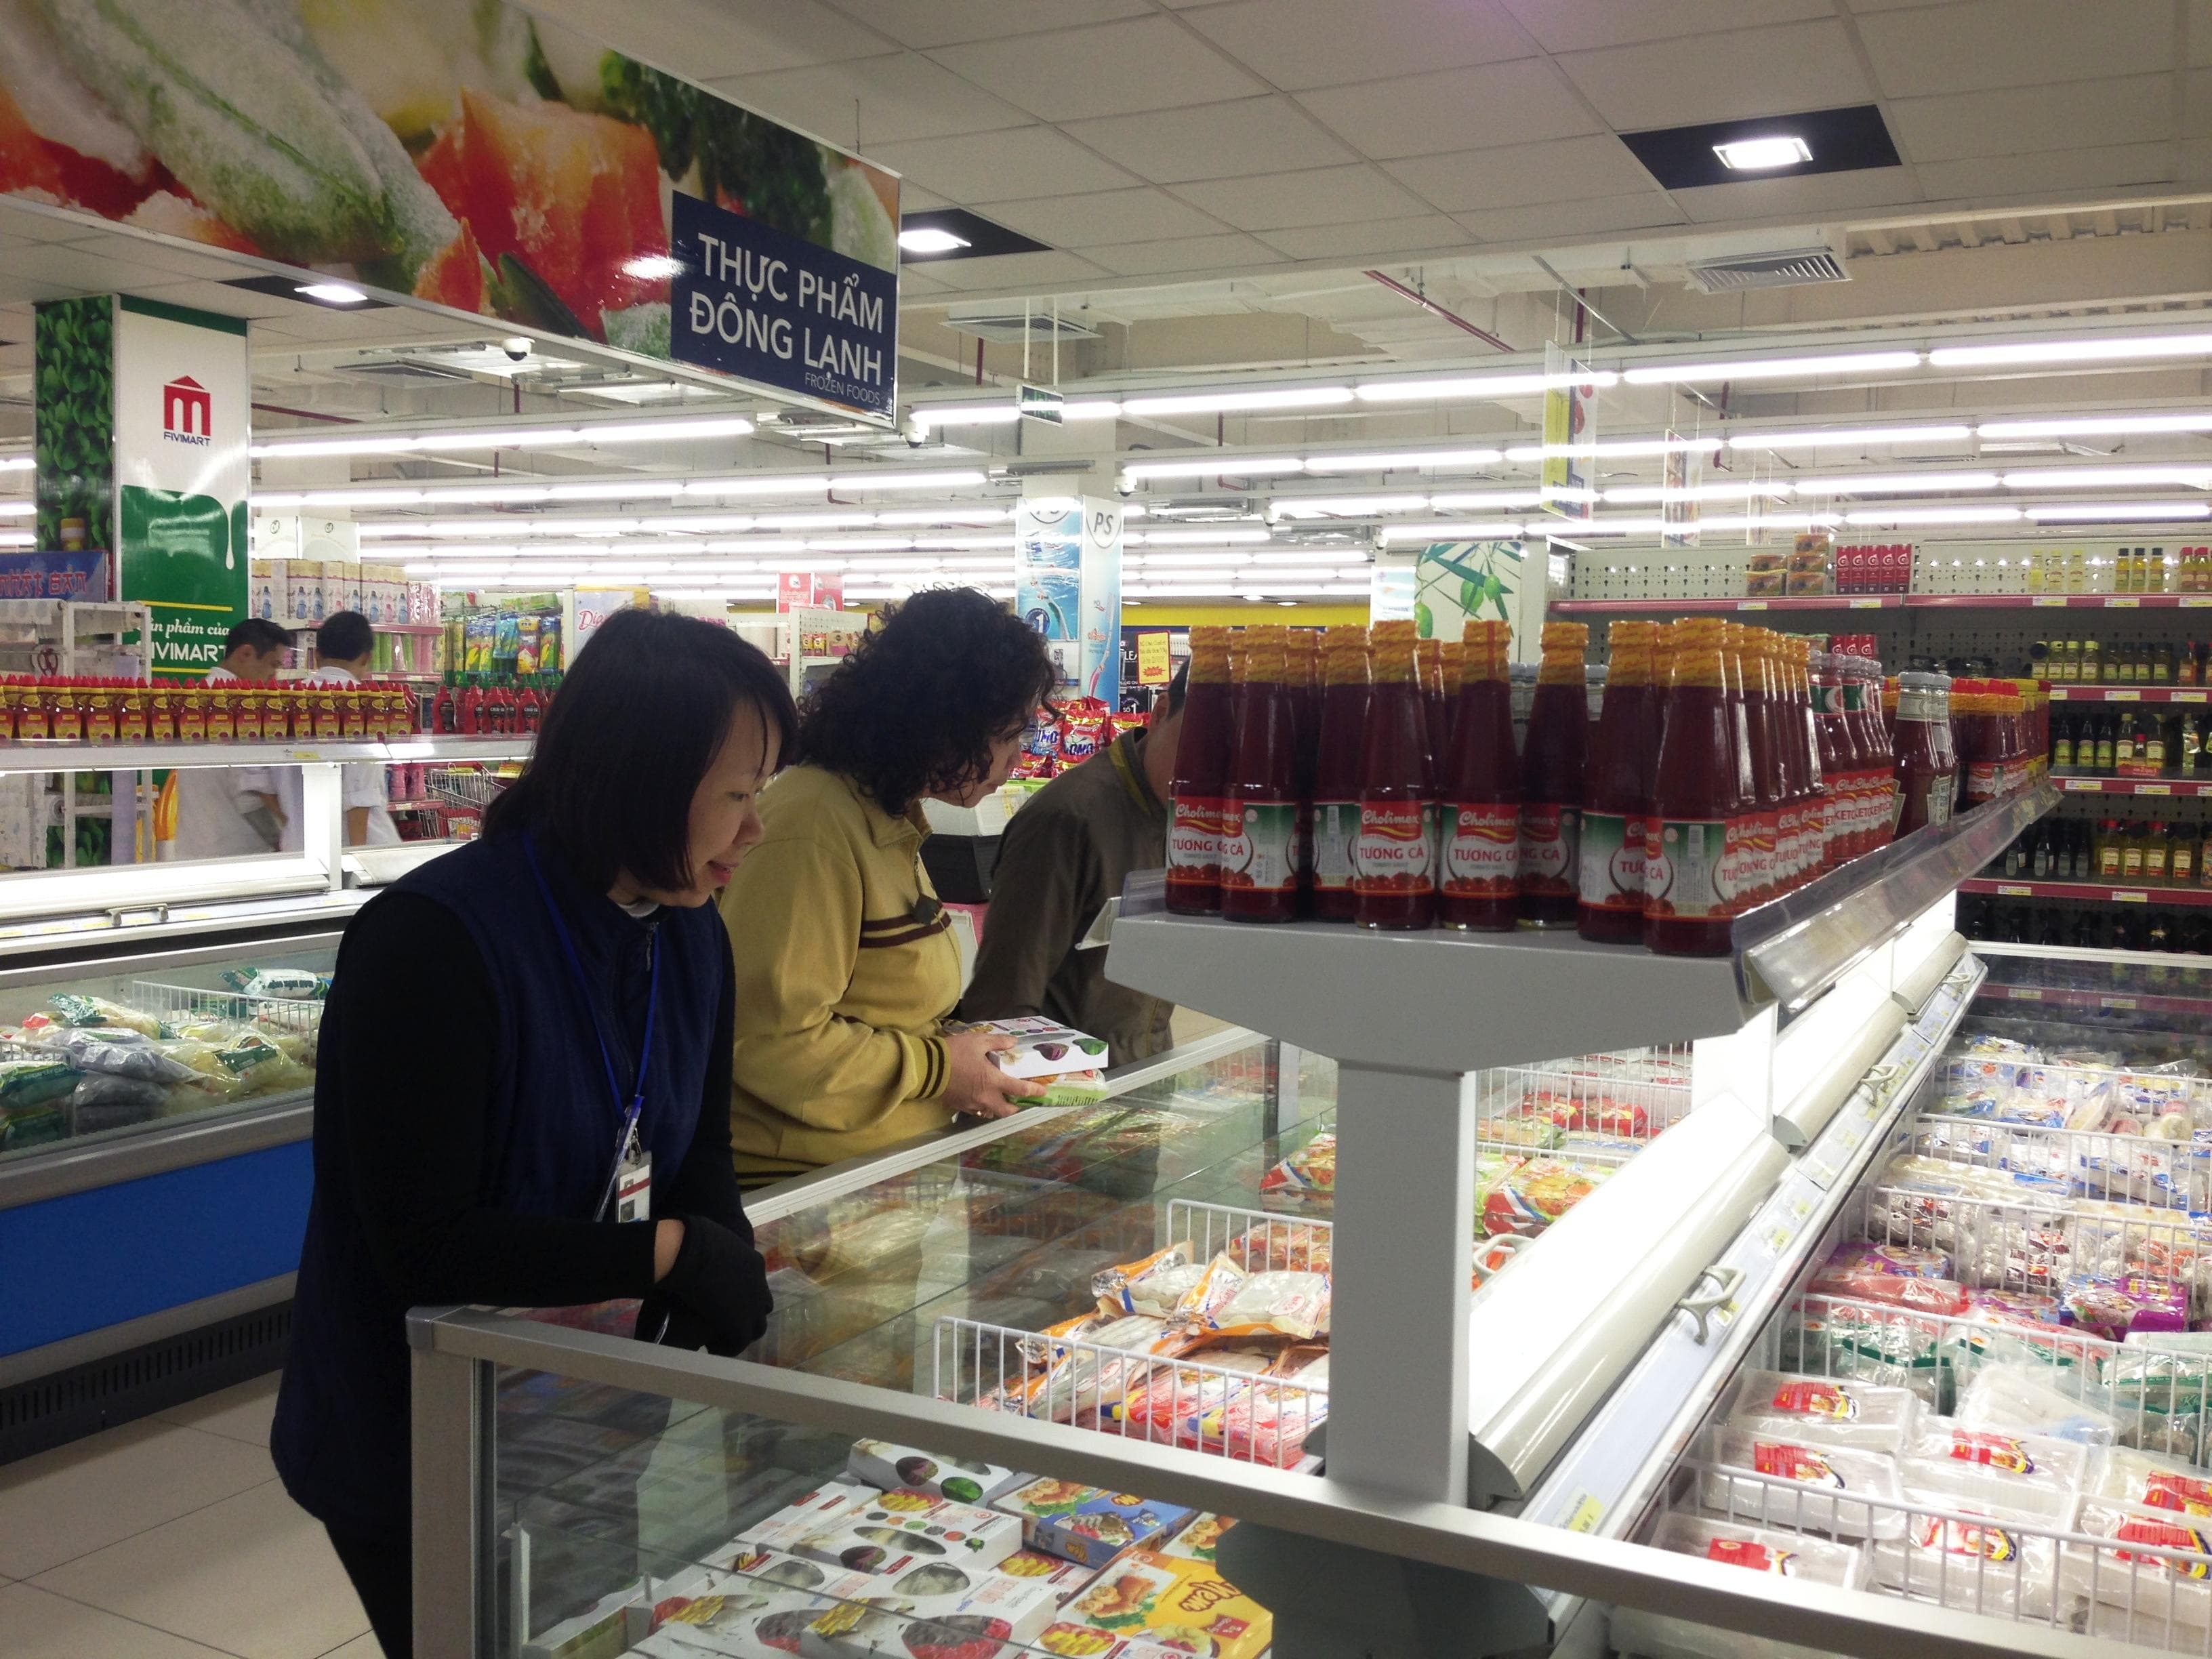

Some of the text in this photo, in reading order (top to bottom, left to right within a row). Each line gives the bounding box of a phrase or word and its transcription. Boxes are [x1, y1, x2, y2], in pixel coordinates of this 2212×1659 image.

[697, 232, 883, 333] THỰC PHẨM
[689, 291, 882, 386] ĐÔNG LẠNH
[804, 373, 880, 406] FROZEN FOODS
[163, 431, 211, 447] FIVIMART
[1094, 512, 1113, 535] PS
[165, 617, 204, 638] phẩm
[207, 622, 230, 636] của
[579, 610, 607, 630] Dia
[138, 640, 227, 662] IVIMART
[1361, 809, 1420, 825] Cholimex
[1359, 844, 1424, 859] TƯƠNG CÀ
